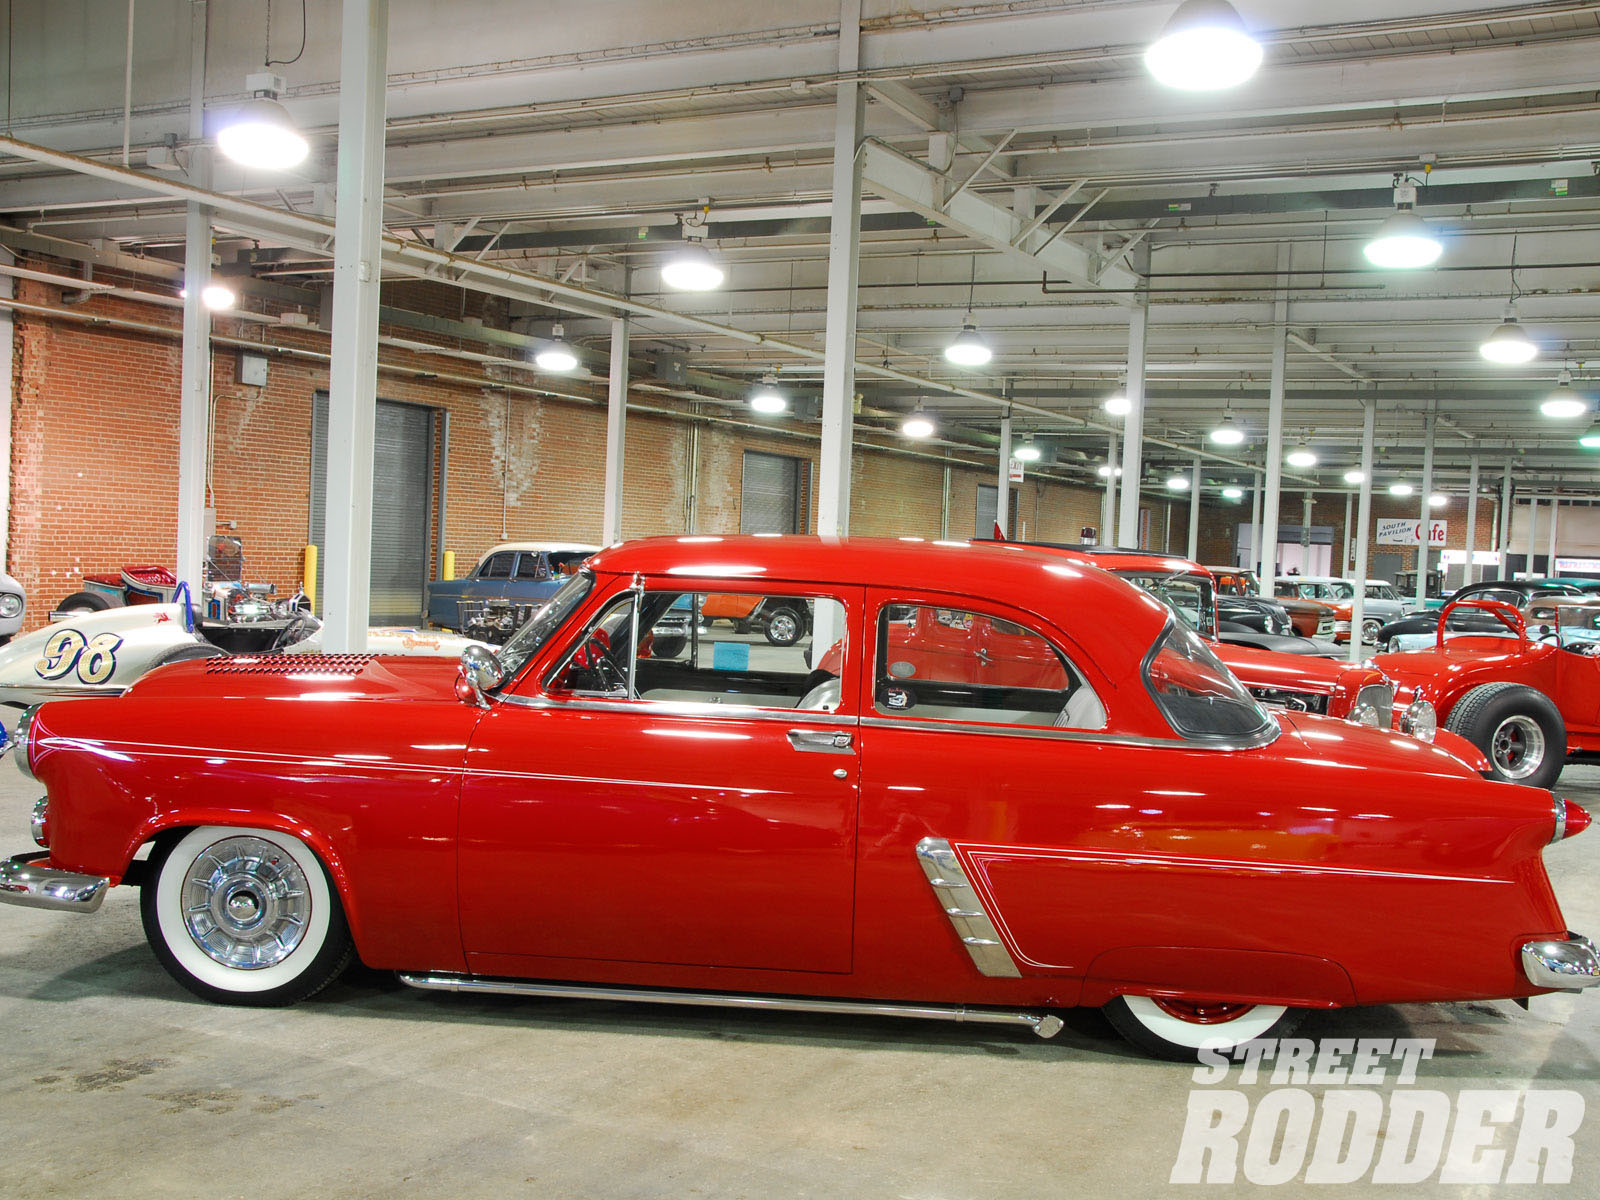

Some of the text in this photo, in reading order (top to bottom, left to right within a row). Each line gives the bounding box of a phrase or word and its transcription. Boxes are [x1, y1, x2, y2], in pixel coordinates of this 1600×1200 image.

[1382, 522, 1406, 530] SOUTH
[1379, 528, 1412, 536] PAVILION
[34, 628, 124, 685] 98
